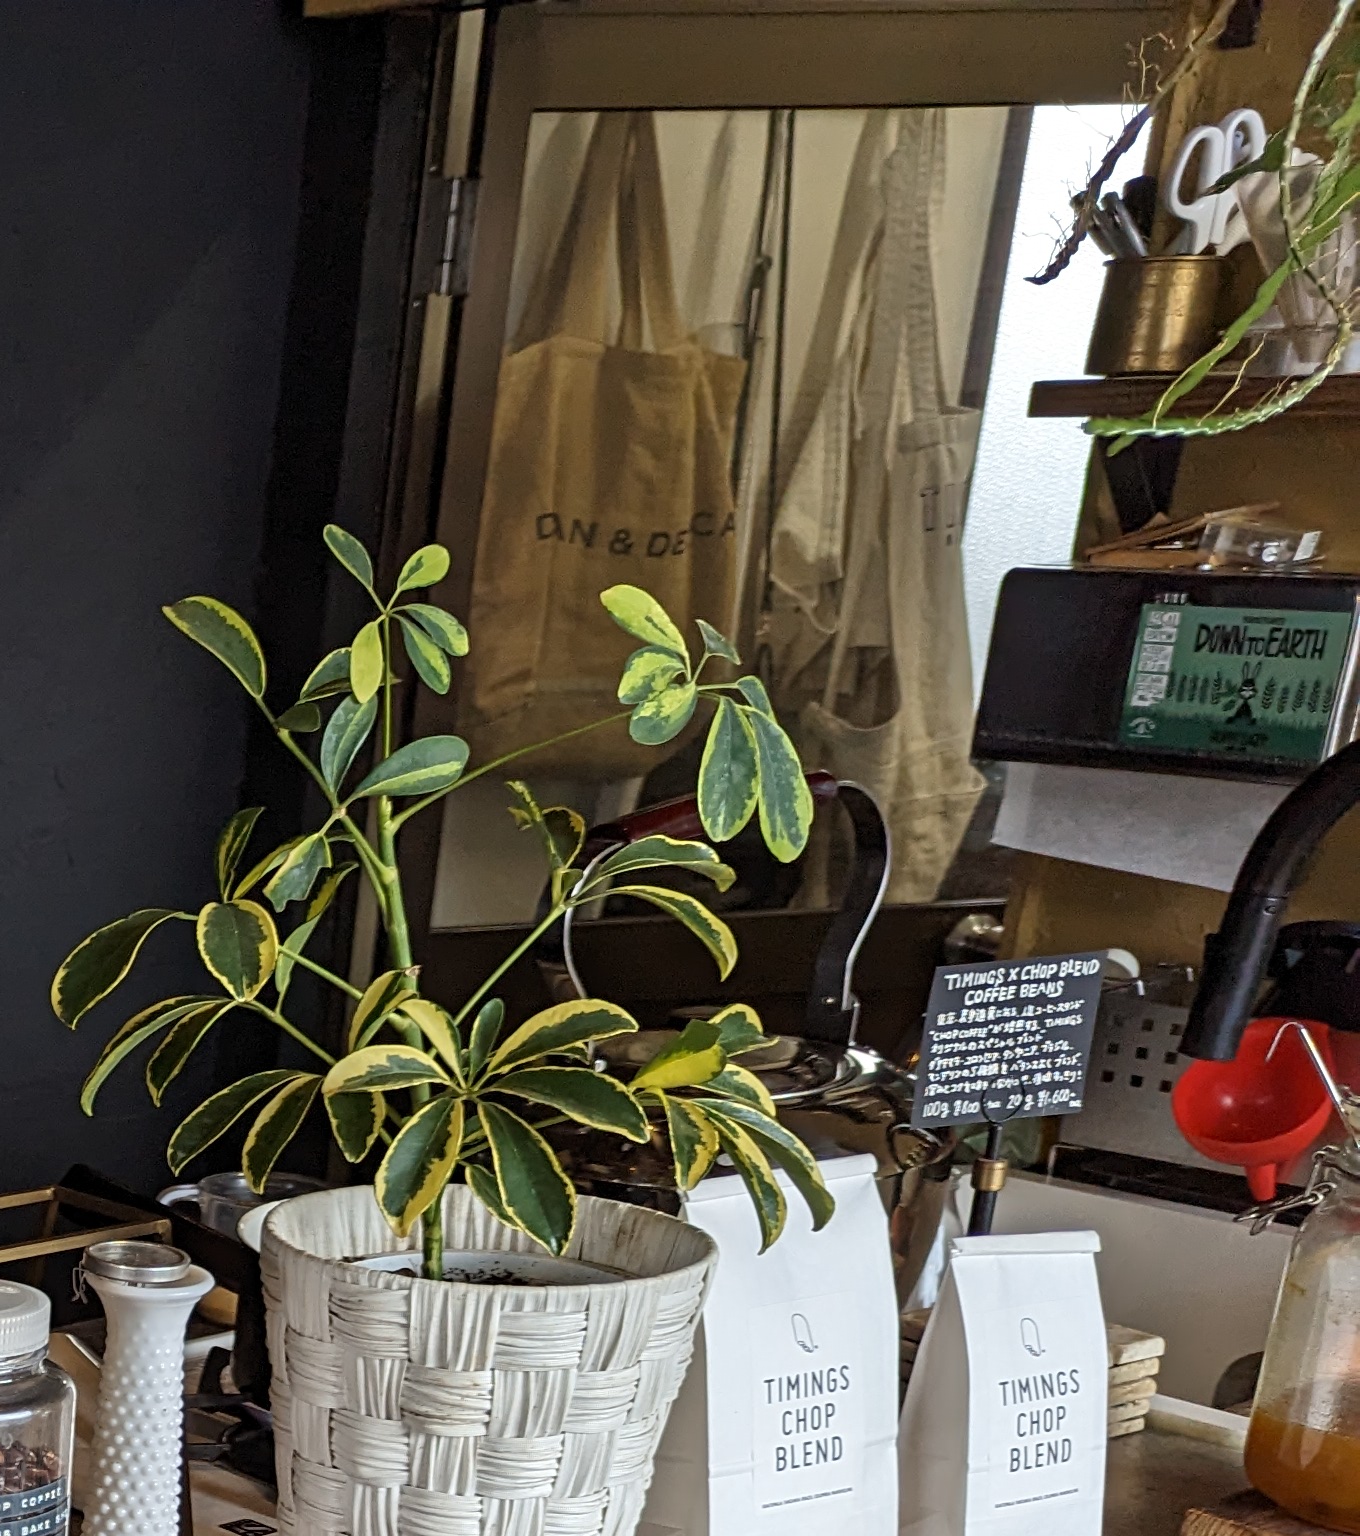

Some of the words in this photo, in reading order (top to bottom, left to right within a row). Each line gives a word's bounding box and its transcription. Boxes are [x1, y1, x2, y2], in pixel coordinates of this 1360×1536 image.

[609, 528, 634, 555] &
[1194, 622, 1246, 656] DOWN
[1265, 626, 1329, 661] EARTH
[944, 967, 1006, 991] TIMINGS
[1021, 964, 1058, 981] CHOP
[1059, 959, 1101, 978] BLEND
[964, 986, 1018, 1007] COFFEE
[1019, 980, 1066, 999] BEANS
[764, 1365, 851, 1405] TIMINGS
[998, 1369, 1081, 1407] TIMINGS
[782, 1402, 837, 1436] CHOP
[1016, 1405, 1067, 1438] CHOP
[775, 1435, 844, 1473] BLEND
[1009, 1438, 1072, 1473] BLEND
[21, 1519, 51, 1536] BAKE
